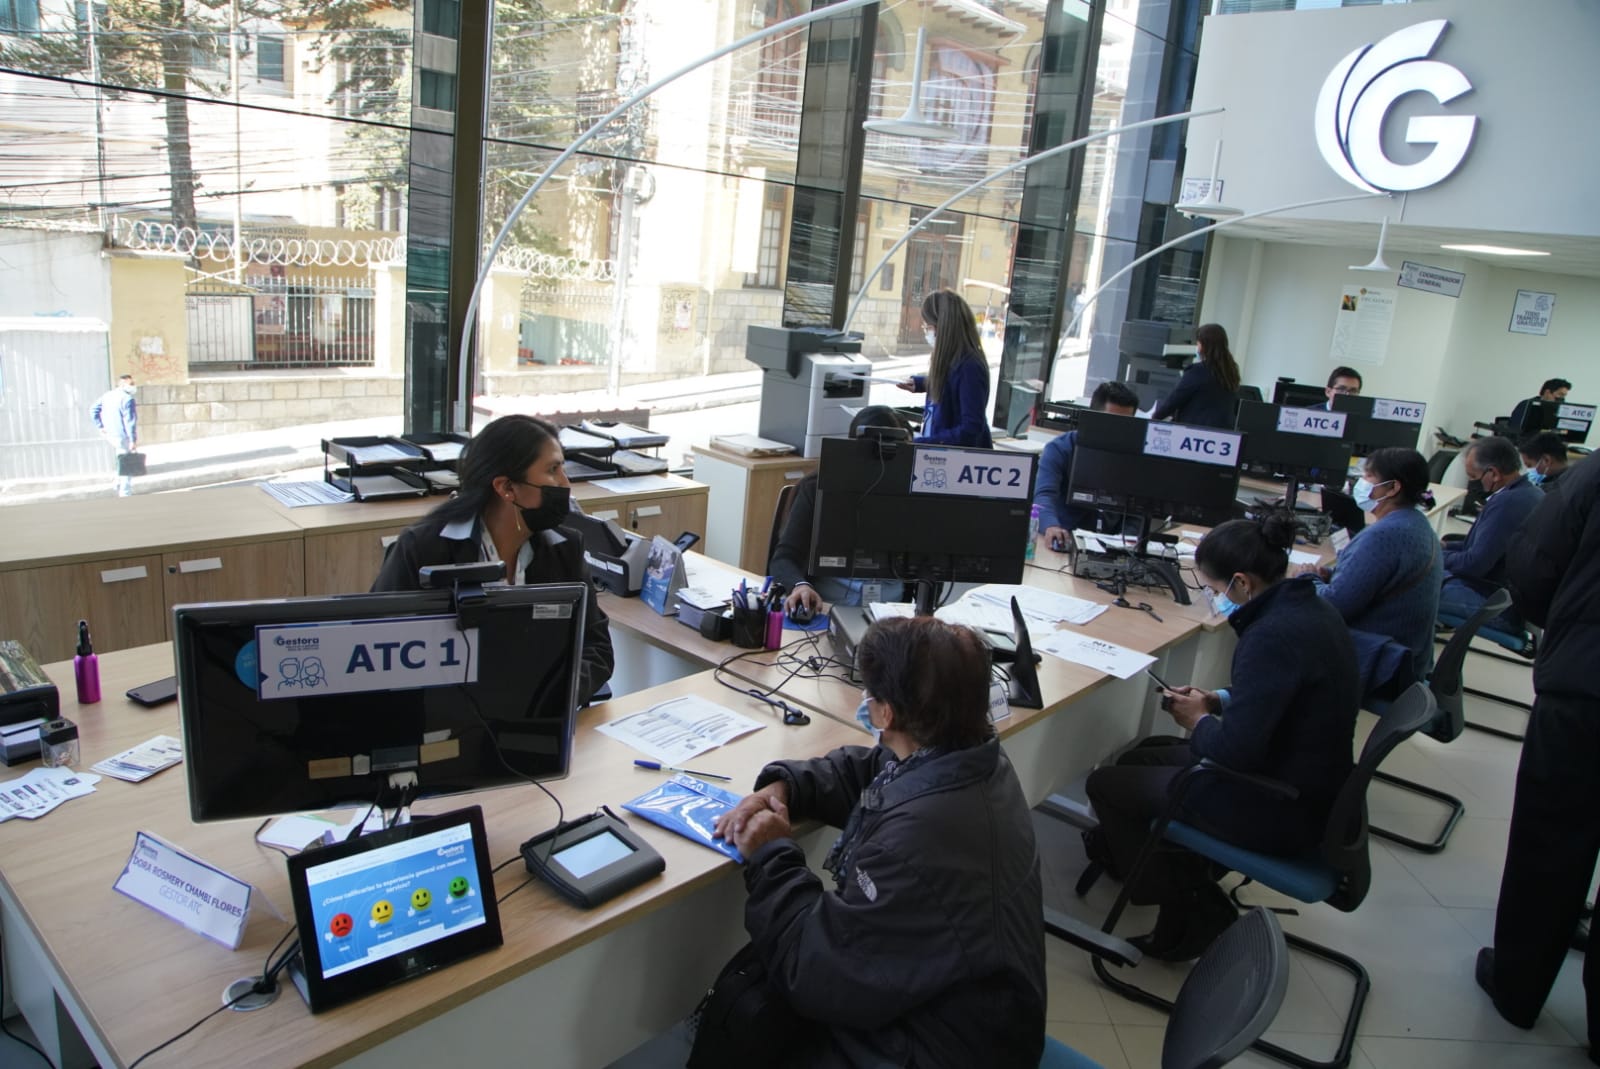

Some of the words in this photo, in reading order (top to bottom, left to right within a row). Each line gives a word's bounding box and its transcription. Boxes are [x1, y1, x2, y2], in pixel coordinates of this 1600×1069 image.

[1392, 406, 1413, 417] ATC
[1413, 408, 1421, 418] 5
[1571, 409, 1586, 417] ATC
[1304, 416, 1329, 430] ATC
[1331, 420, 1340, 431] 4
[1180, 436, 1216, 454] ATC
[1219, 441, 1232, 456] 3
[957, 464, 1002, 486] ATC
[1007, 468, 1021, 487] 2
[275, 635, 320, 647] Gestora
[346, 639, 426, 674] ATC
[439, 637, 461, 667] 1
[132, 856, 152, 873] DORA
[152, 865, 185, 889] ROSMERY
[184, 882, 212, 904] CHAMBI
[210, 897, 243, 918] FLORES
[188, 900, 203, 915] ATC
